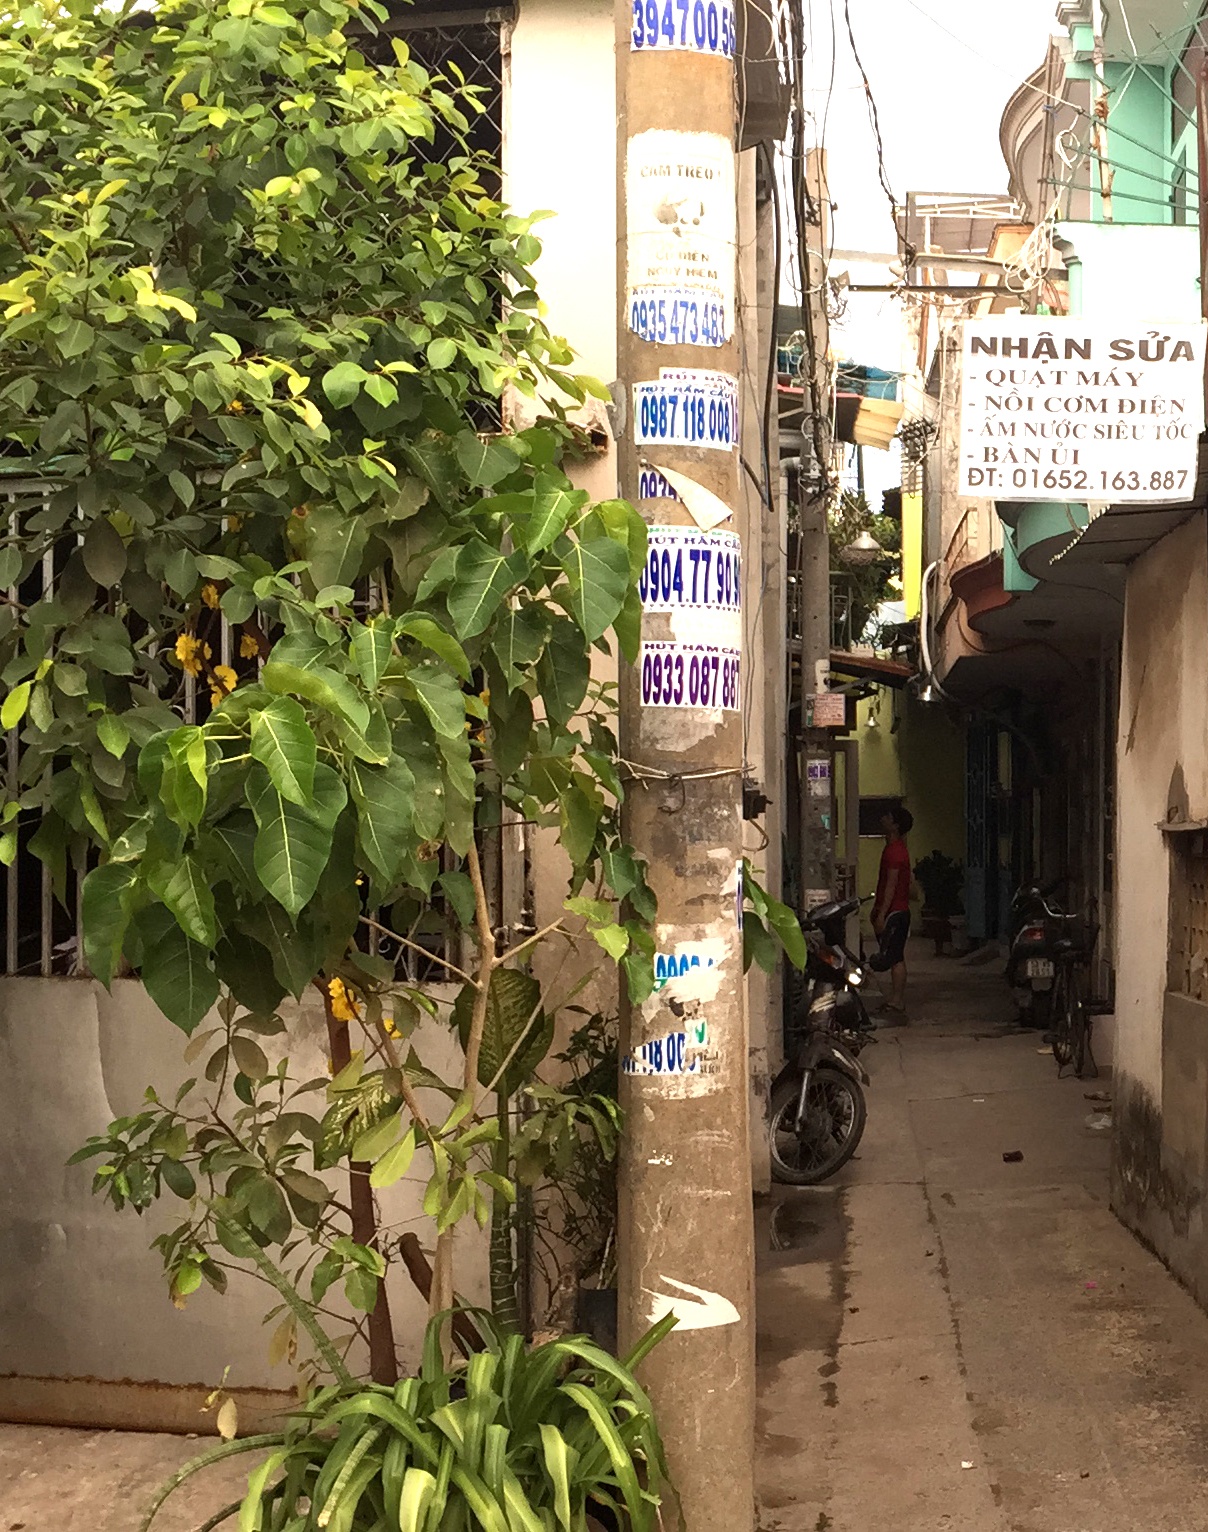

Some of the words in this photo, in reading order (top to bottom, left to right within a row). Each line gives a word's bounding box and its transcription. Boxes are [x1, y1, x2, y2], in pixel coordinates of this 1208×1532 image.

[971, 331, 1091, 364] NHẬN
[1108, 331, 1195, 362] SỬA
[985, 369, 1068, 388] QUẠT
[1076, 366, 1144, 387] MÁY
[985, 387, 1034, 412] NỒI
[1044, 395, 1108, 413] CƠM
[1117, 394, 1186, 417] ĐIỆN
[980, 414, 1016, 437] ẤM
[1024, 418, 1088, 440] NƯỚC
[1094, 419, 1145, 440] SIÊU
[1152, 416, 1193, 440] TỐC
[983, 442, 1042, 465] BÀN
[1051, 442, 1080, 465] ỦI
[968, 467, 1003, 487] ĐT:
[1012, 468, 1188, 491] 01652.163.887
